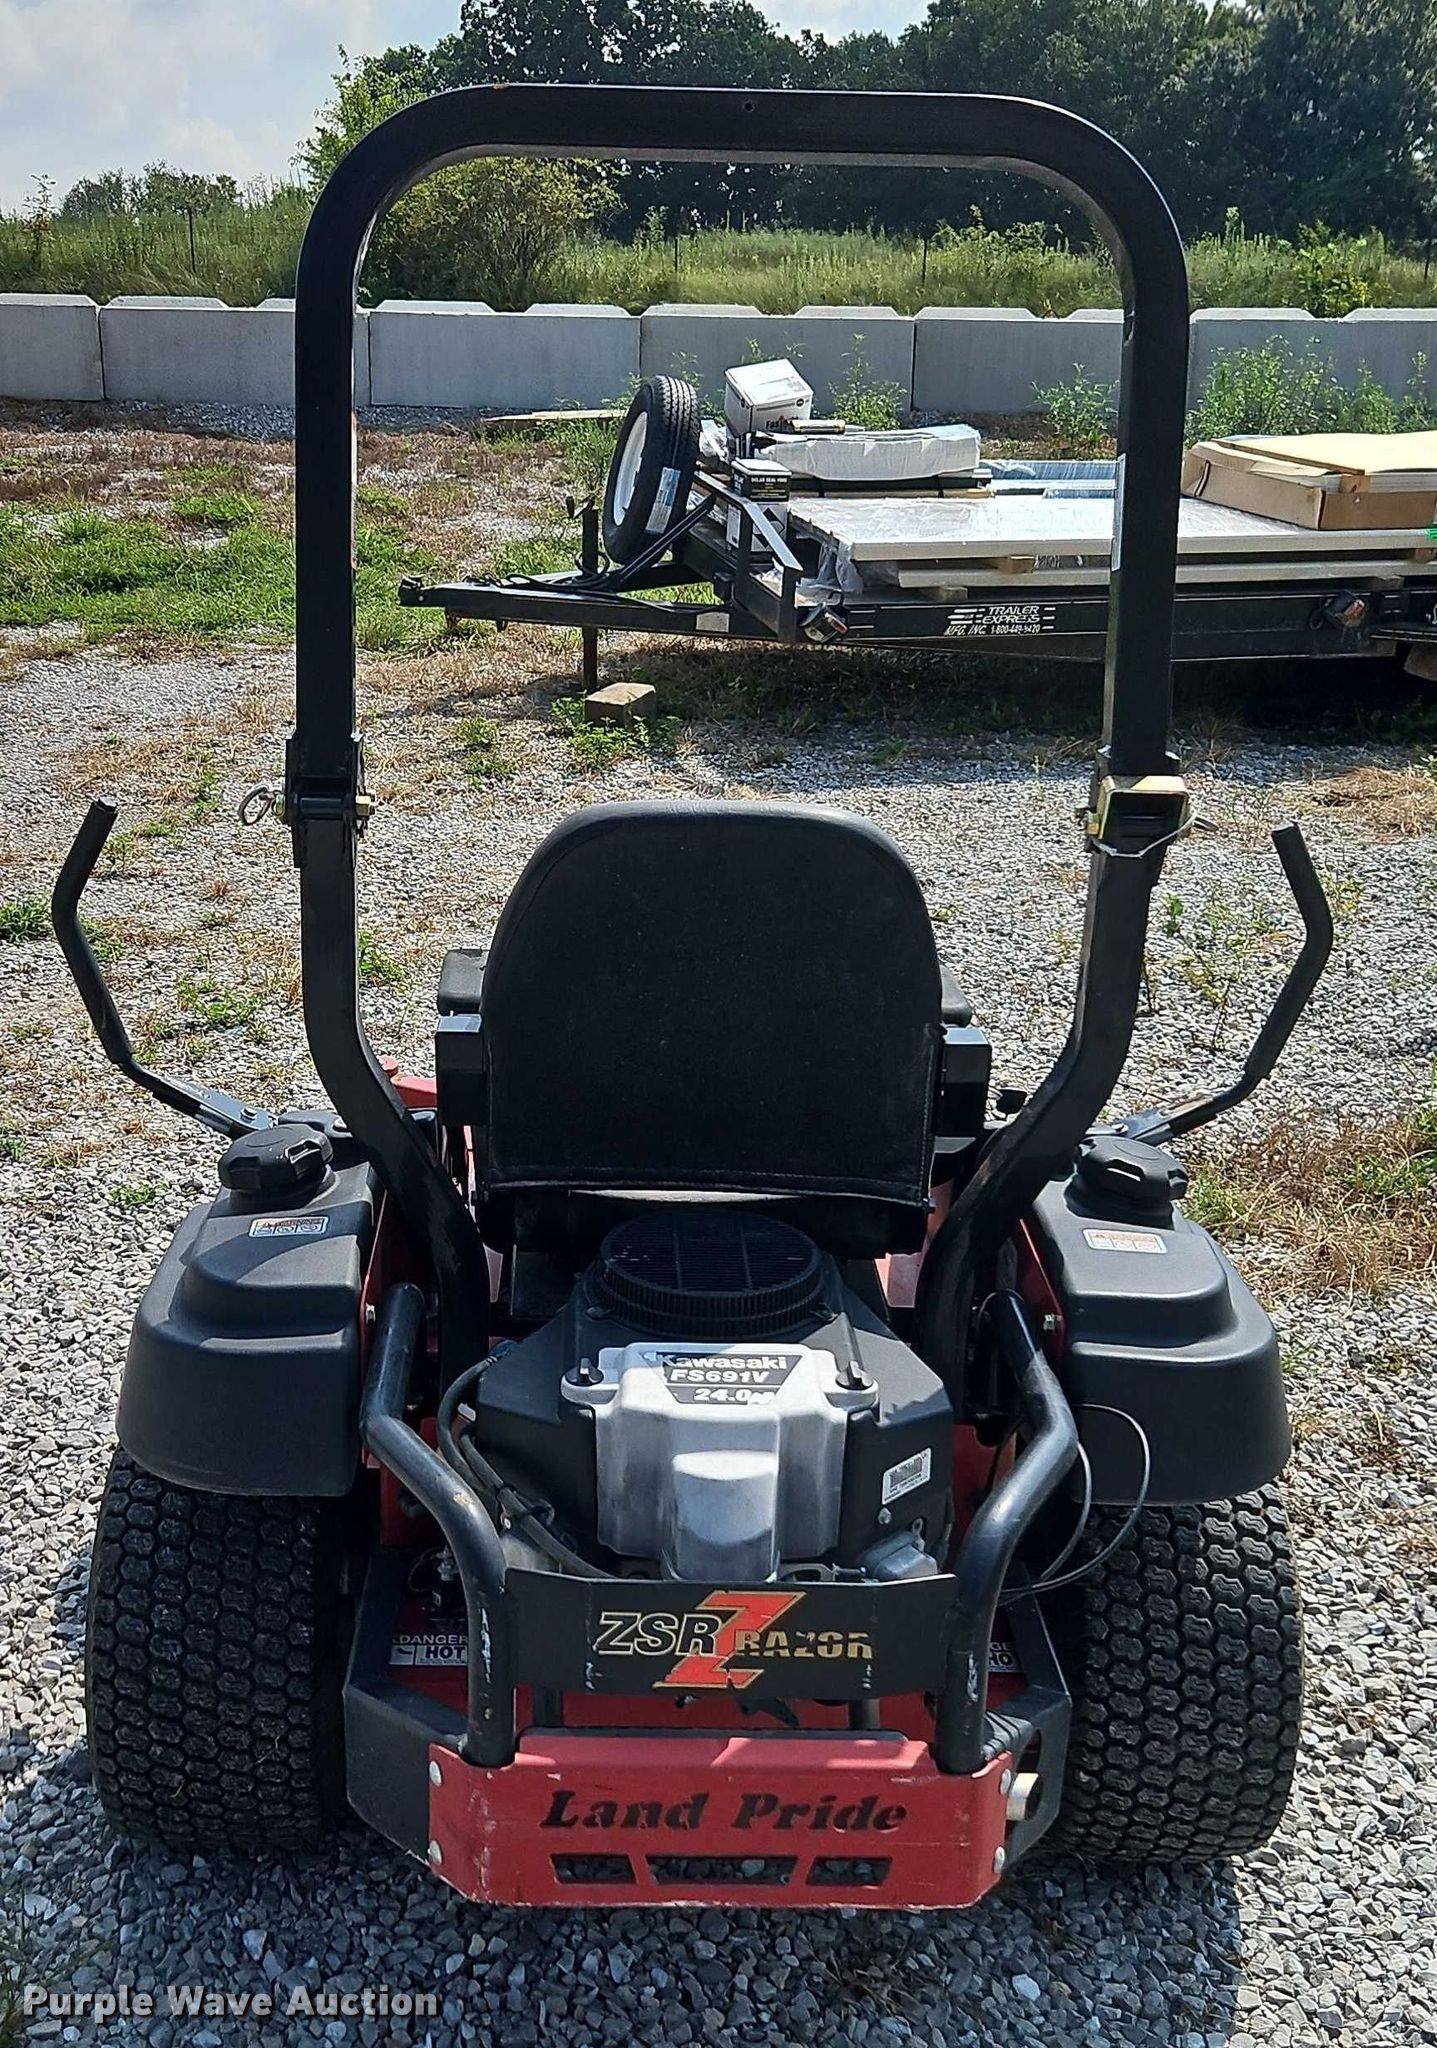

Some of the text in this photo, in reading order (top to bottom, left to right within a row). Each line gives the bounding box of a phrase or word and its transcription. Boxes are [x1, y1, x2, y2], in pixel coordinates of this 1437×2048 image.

[989, 605, 1040, 615] TRAILER
[656, 1354, 788, 1370] Kawasaki
[670, 1369, 770, 1384] FS691V
[400, 1634, 468, 1645] DANGER
[593, 1611, 723, 1657] ZSR
[425, 1646, 466, 1659] HOT
[538, 1790, 907, 1833] Land Pride
